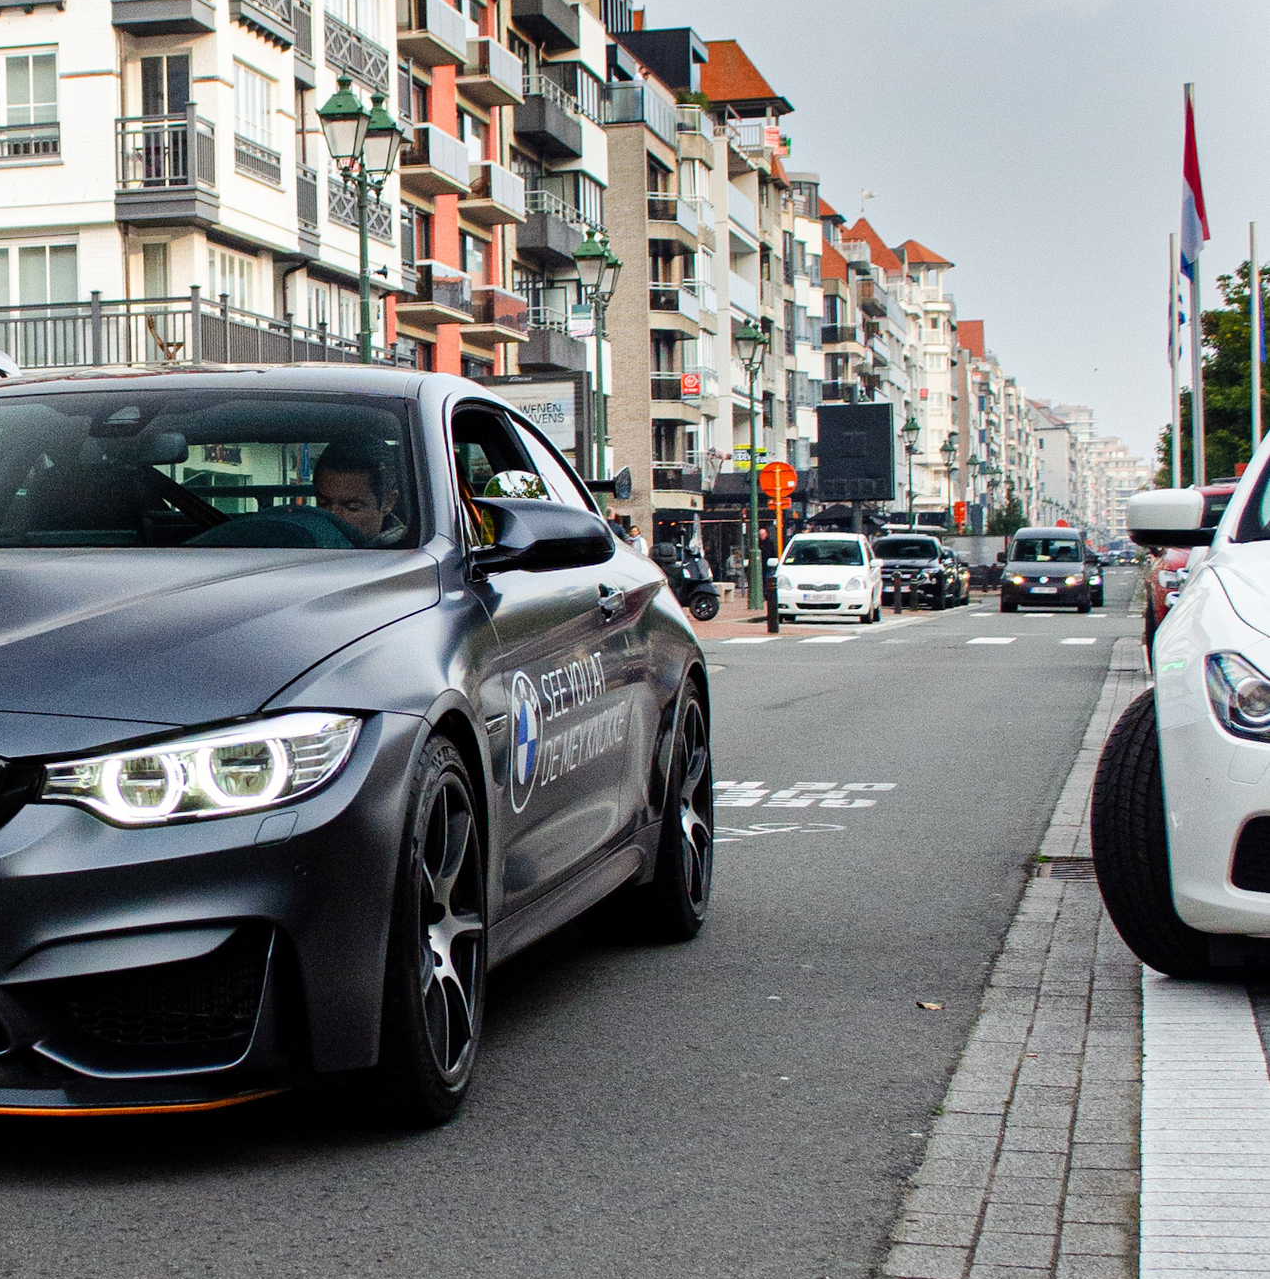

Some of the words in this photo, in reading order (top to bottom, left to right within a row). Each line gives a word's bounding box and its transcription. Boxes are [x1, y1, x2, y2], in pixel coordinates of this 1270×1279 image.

[541, 669, 569, 721] SEE
[564, 658, 592, 710] YOU
[590, 651, 606, 699] AT
[541, 735, 561, 787] DE
[560, 724, 586, 776] MEY
